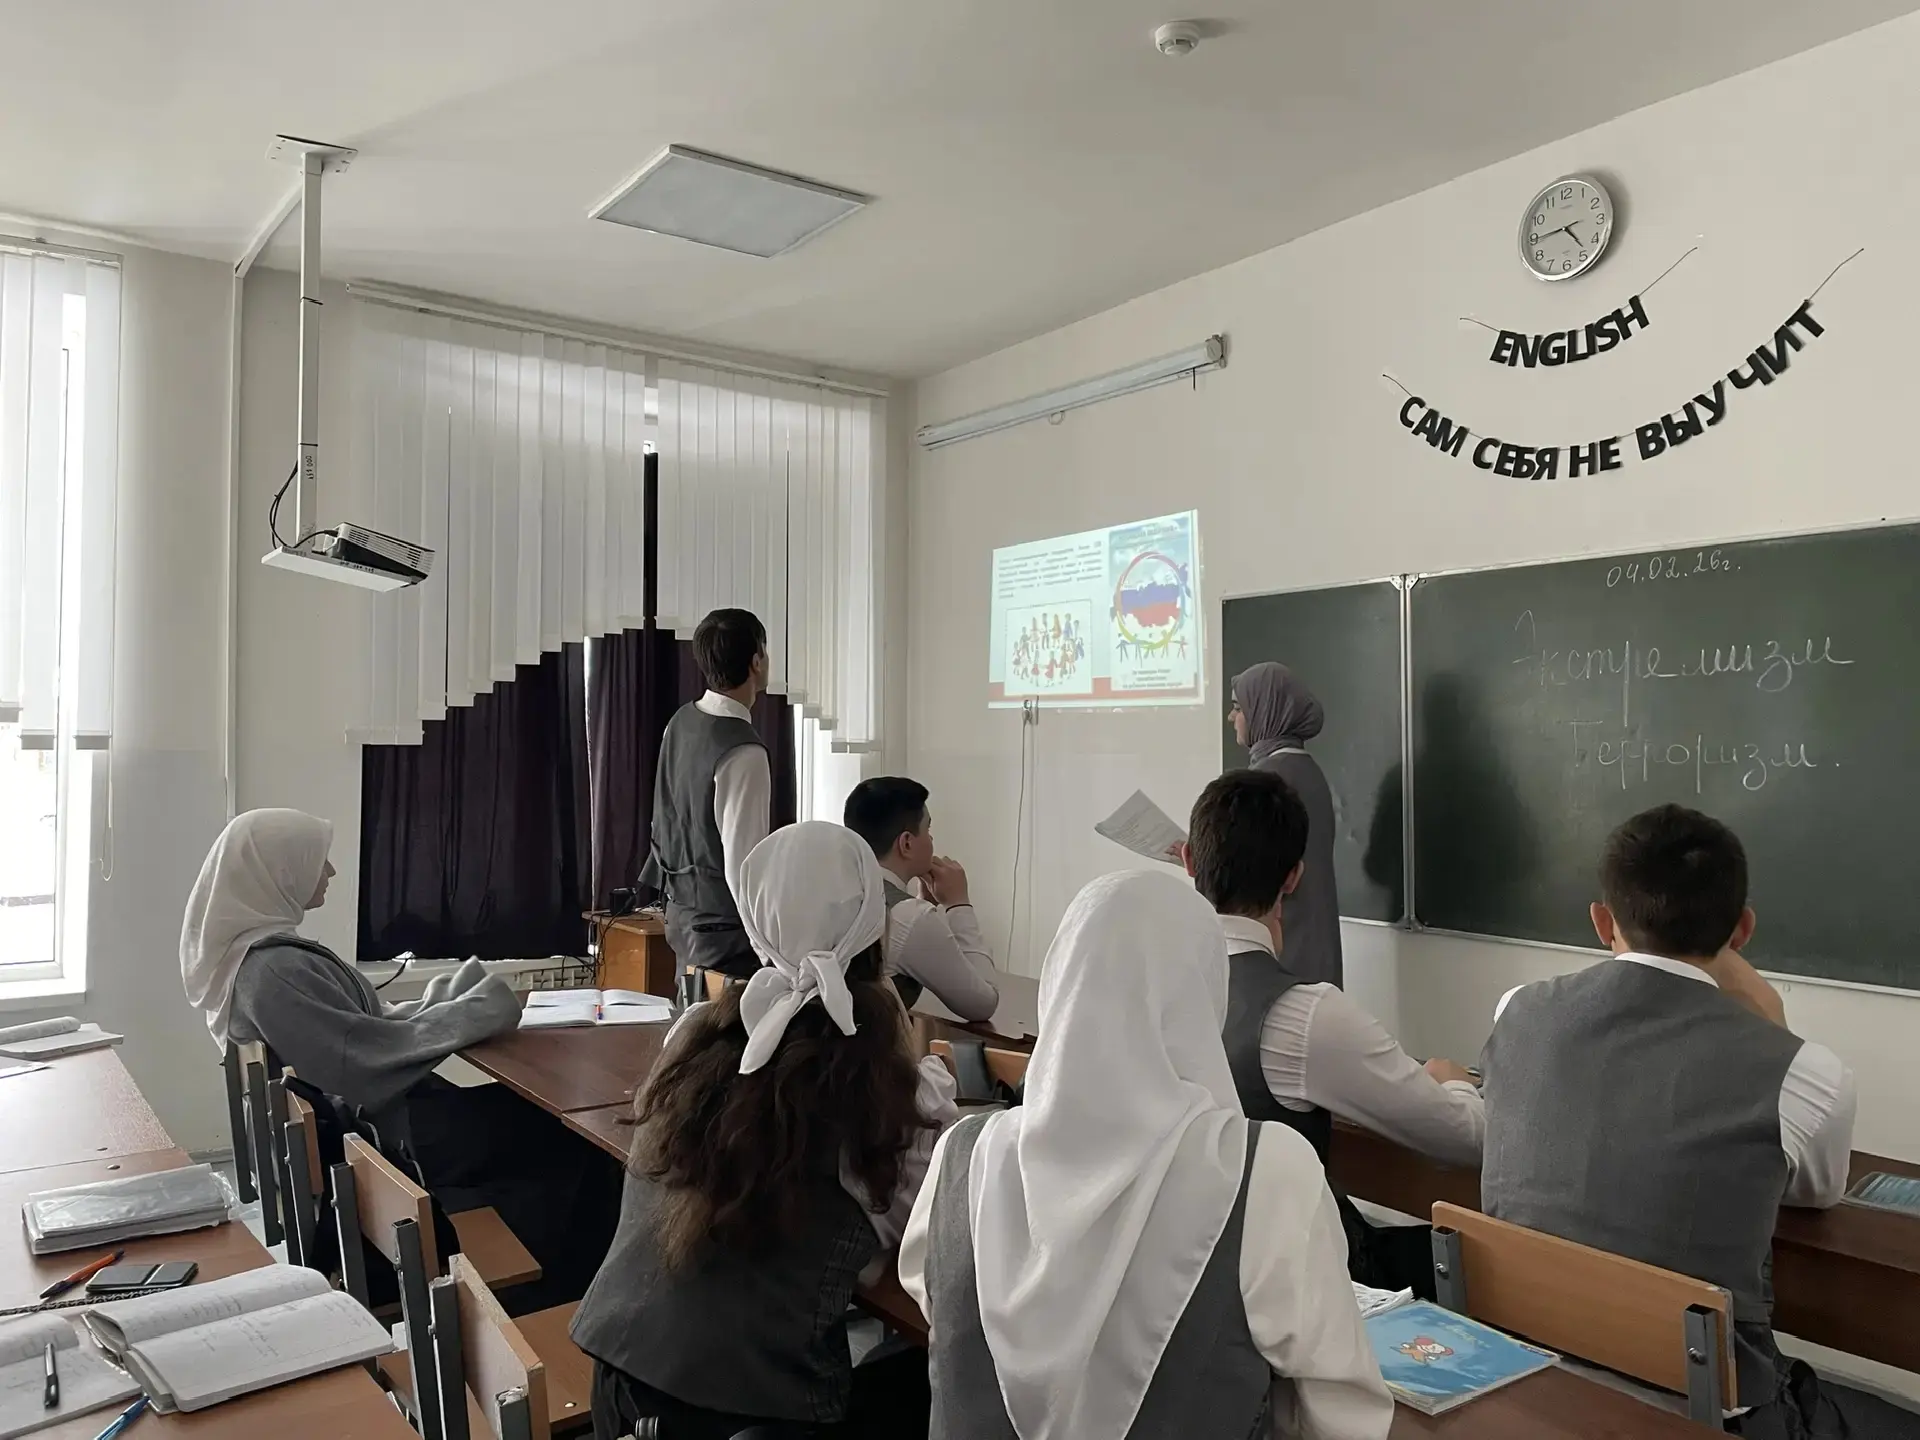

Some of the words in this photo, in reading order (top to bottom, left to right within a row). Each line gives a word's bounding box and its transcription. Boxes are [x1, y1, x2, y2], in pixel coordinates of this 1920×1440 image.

[1560, 187, 1573, 200] 12
[1581, 187, 1584, 198] 1
[1546, 196, 1555, 209] 11
[1590, 197, 1600, 210] 2
[1532, 214, 1545, 226] 10
[1596, 213, 1605, 225] 3
[1529, 233, 1539, 246] 9
[1590, 232, 1599, 244] 4
[1535, 250, 1544, 261] 8
[1578, 250, 1588, 262] 5
[1546, 259, 1555, 271] 7
[1562, 260, 1572, 271] 6
[1490, 295, 1649, 368] ENGLISH
[1399, 396, 1470, 458] САМ
[1472, 437, 1559, 480] СЕБЯ
[1568, 436, 1623, 478] НЕ
